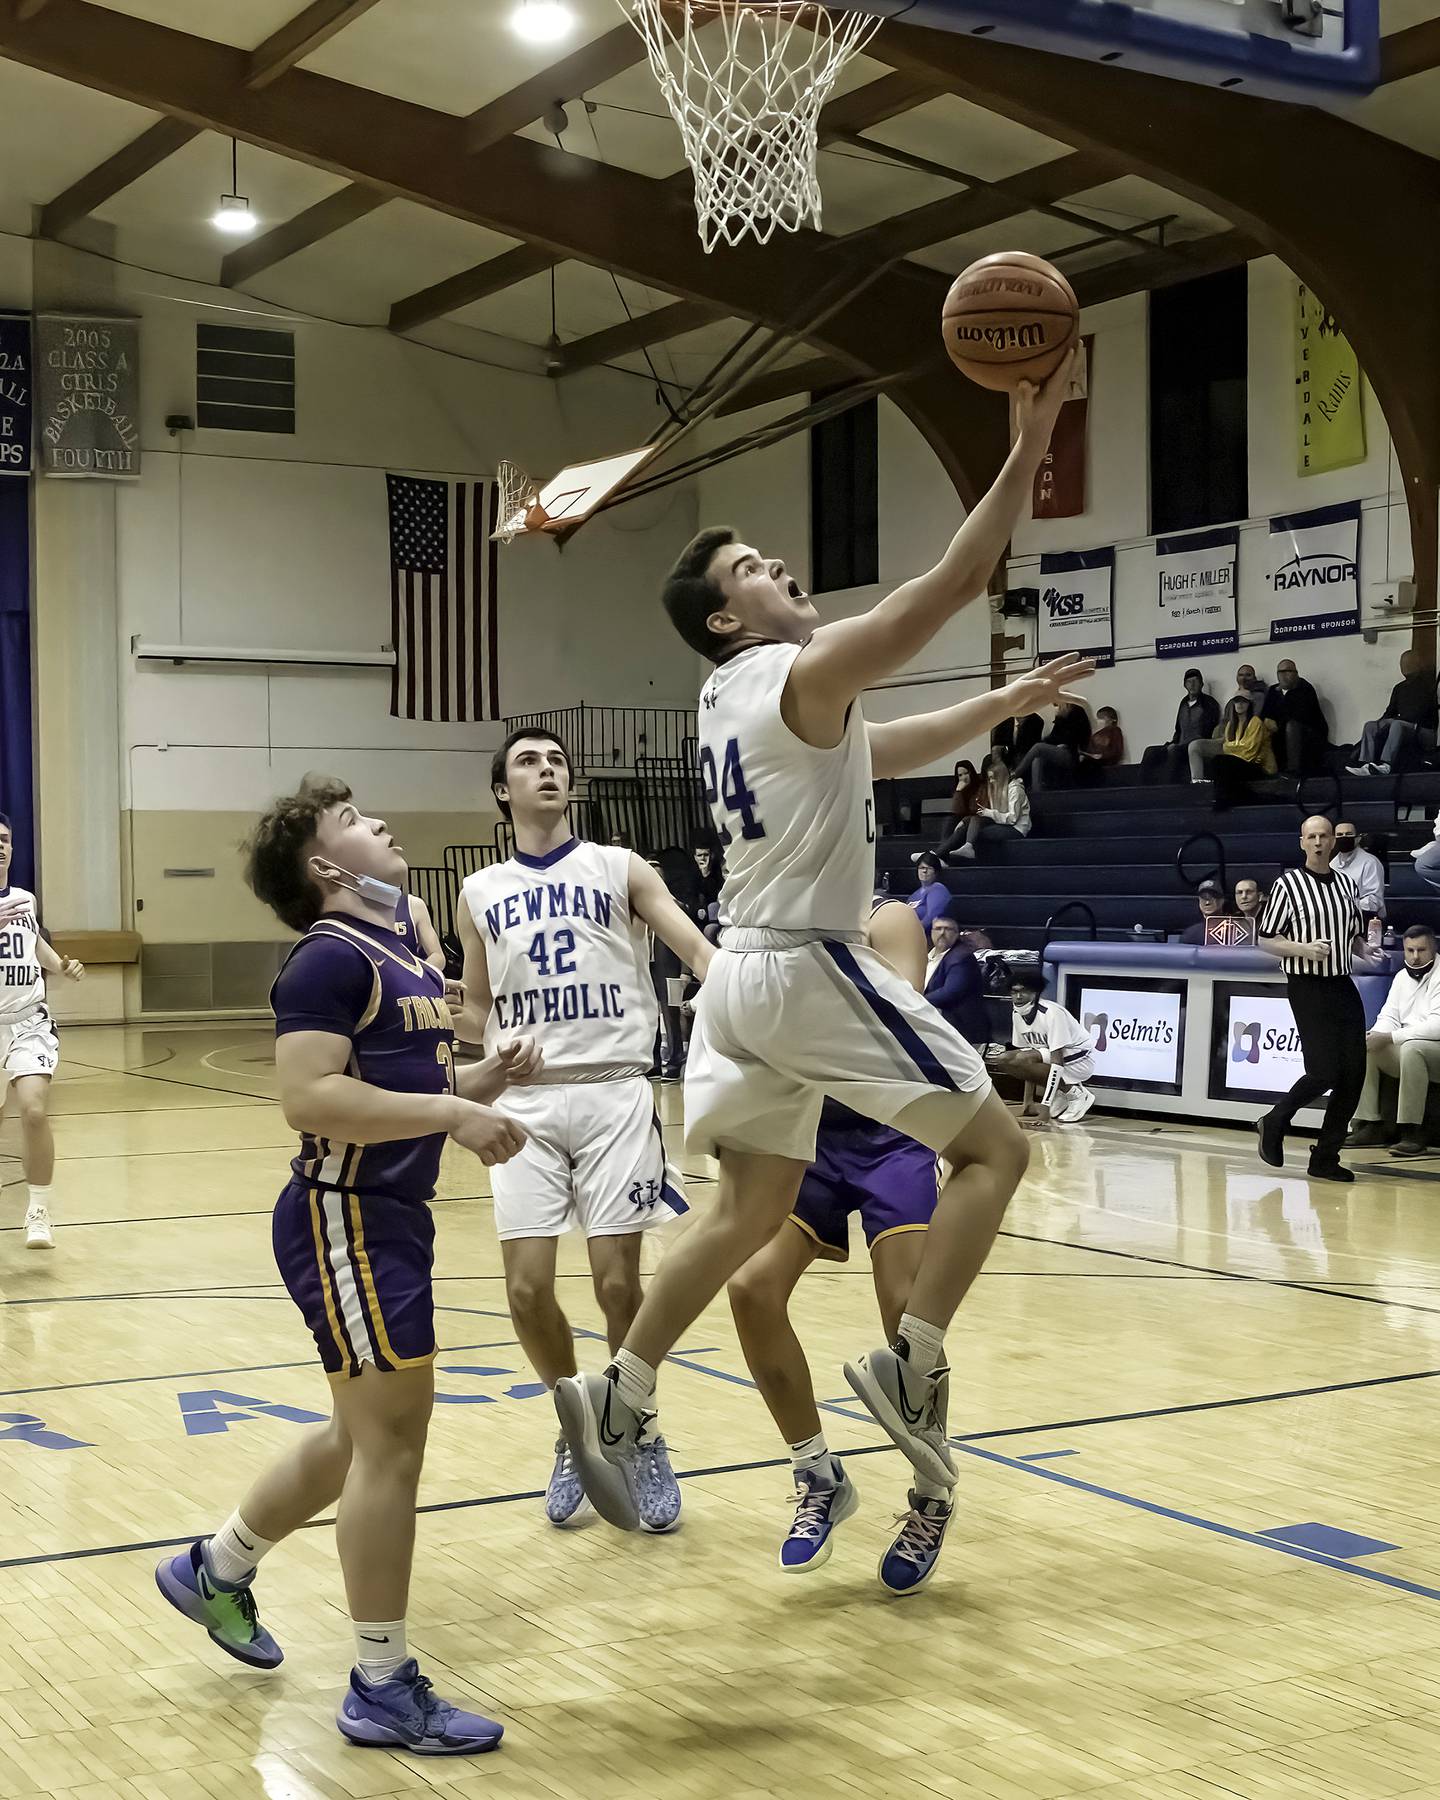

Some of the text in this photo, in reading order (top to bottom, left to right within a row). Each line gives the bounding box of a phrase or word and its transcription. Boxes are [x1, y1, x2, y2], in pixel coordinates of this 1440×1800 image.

[956, 322, 1046, 350] Wilson
[49, 350, 128, 370] CLASS A
[61, 373, 118, 392] GIRLS
[46, 392, 139, 450] BASKETBALL
[52, 449, 132, 470] FOURTH
[1163, 574, 1189, 591] HUGH
[1200, 567, 1230, 586] MILLER
[1274, 563, 1357, 591] RAYNOR
[1273, 618, 1356, 634] CORPORATE SPONSOR
[1159, 636, 1235, 651] CORPORATE SPONSOR
[484, 882, 614, 945] NEWMAN
[528, 928, 577, 976] 42
[494, 982, 625, 1030] CATHOLIC
[1109, 1018, 1174, 1044] Selmi's
